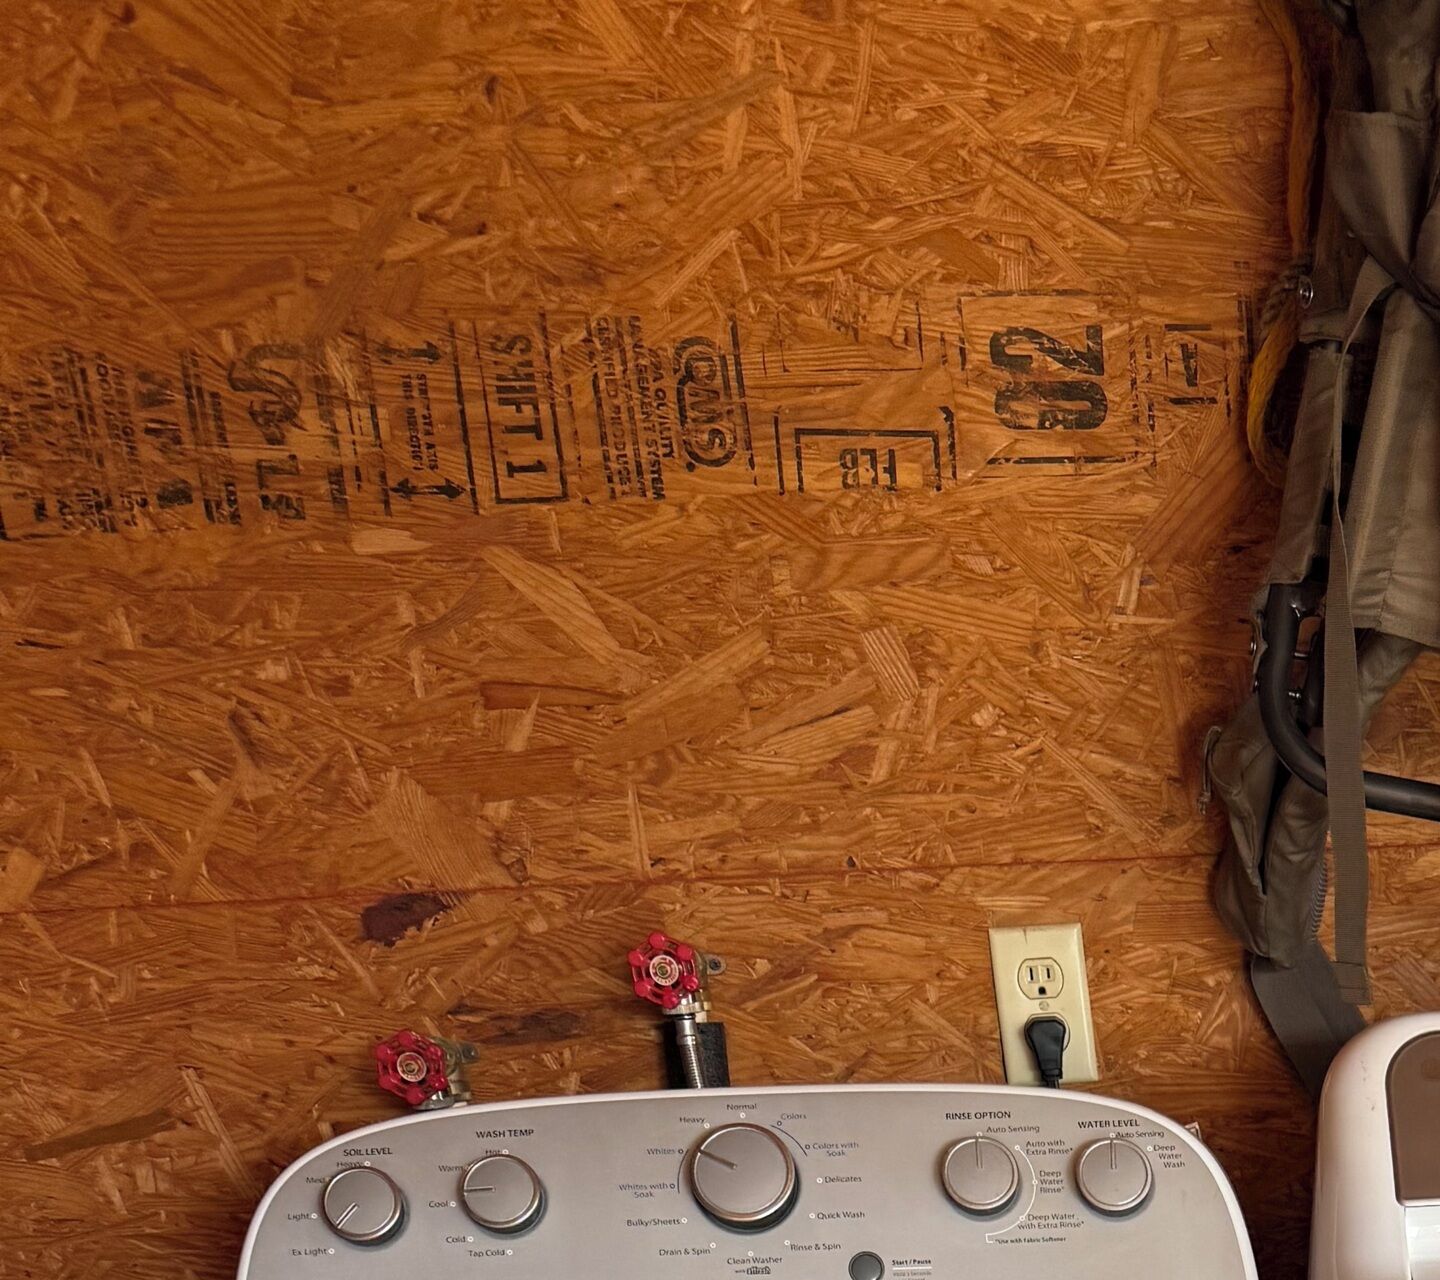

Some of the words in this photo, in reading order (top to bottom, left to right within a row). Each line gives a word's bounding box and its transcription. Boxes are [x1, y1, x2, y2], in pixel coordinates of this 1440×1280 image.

[492, 334, 544, 441] SHIFT
[726, 1102, 758, 1111] Normal
[780, 1112, 808, 1120] Colors
[945, 1111, 973, 1120] RINSE
[974, 1110, 1011, 1119] OPTION
[1077, 1120, 1111, 1129] WATER
[1112, 1118, 1141, 1128] LEVEL
[475, 1130, 506, 1139] WASH
[508, 1128, 535, 1138] TEMP
[986, 1125, 1007, 1133] Auto
[1008, 1124, 1040, 1134] Sensing
[1116, 1131, 1135, 1139] Auto
[1135, 1130, 1164, 1139] Sensing
[812, 1142, 839, 1150] Colors
[840, 1140, 860, 1149] with
[1025, 1140, 1045, 1148] Auto
[1046, 1139, 1066, 1147] with
[1153, 1144, 1176, 1152] Deep
[343, 1148, 364, 1157] SOIL
[366, 1147, 393, 1156] LEVEL
[646, 1147, 676, 1155] Whites
[826, 1150, 846, 1158] Soak
[1025, 1148, 1047, 1156] Extra
[1163, 1161, 1186, 1169] Wash
[824, 1174, 863, 1184] Delicates
[1039, 1170, 1062, 1179] Deep
[618, 1183, 648, 1191] Whites
[649, 1181, 669, 1190] with
[633, 1190, 655, 1198] Soak
[287, 1212, 310, 1222] Light
[816, 1211, 841, 1220] Quick
[842, 1210, 866, 1219] Wash
[1027, 1213, 1050, 1222] Deep
[1051, 1212, 1075, 1220] Water
[626, 1217, 681, 1227] Bulky/Sheets
[1018, 1222, 1037, 1230] with
[445, 1235, 466, 1243] Cold
[292, 1248, 302, 1256] Ex
[304, 1247, 328, 1257] Light
[692, 1247, 711, 1257] Spin
[822, 1242, 842, 1252] Spin
[467, 1249, 484, 1257] Tap
[485, 1248, 505, 1256] Cold
[726, 1257, 750, 1265] Clean
[751, 1256, 784, 1265] Washer
